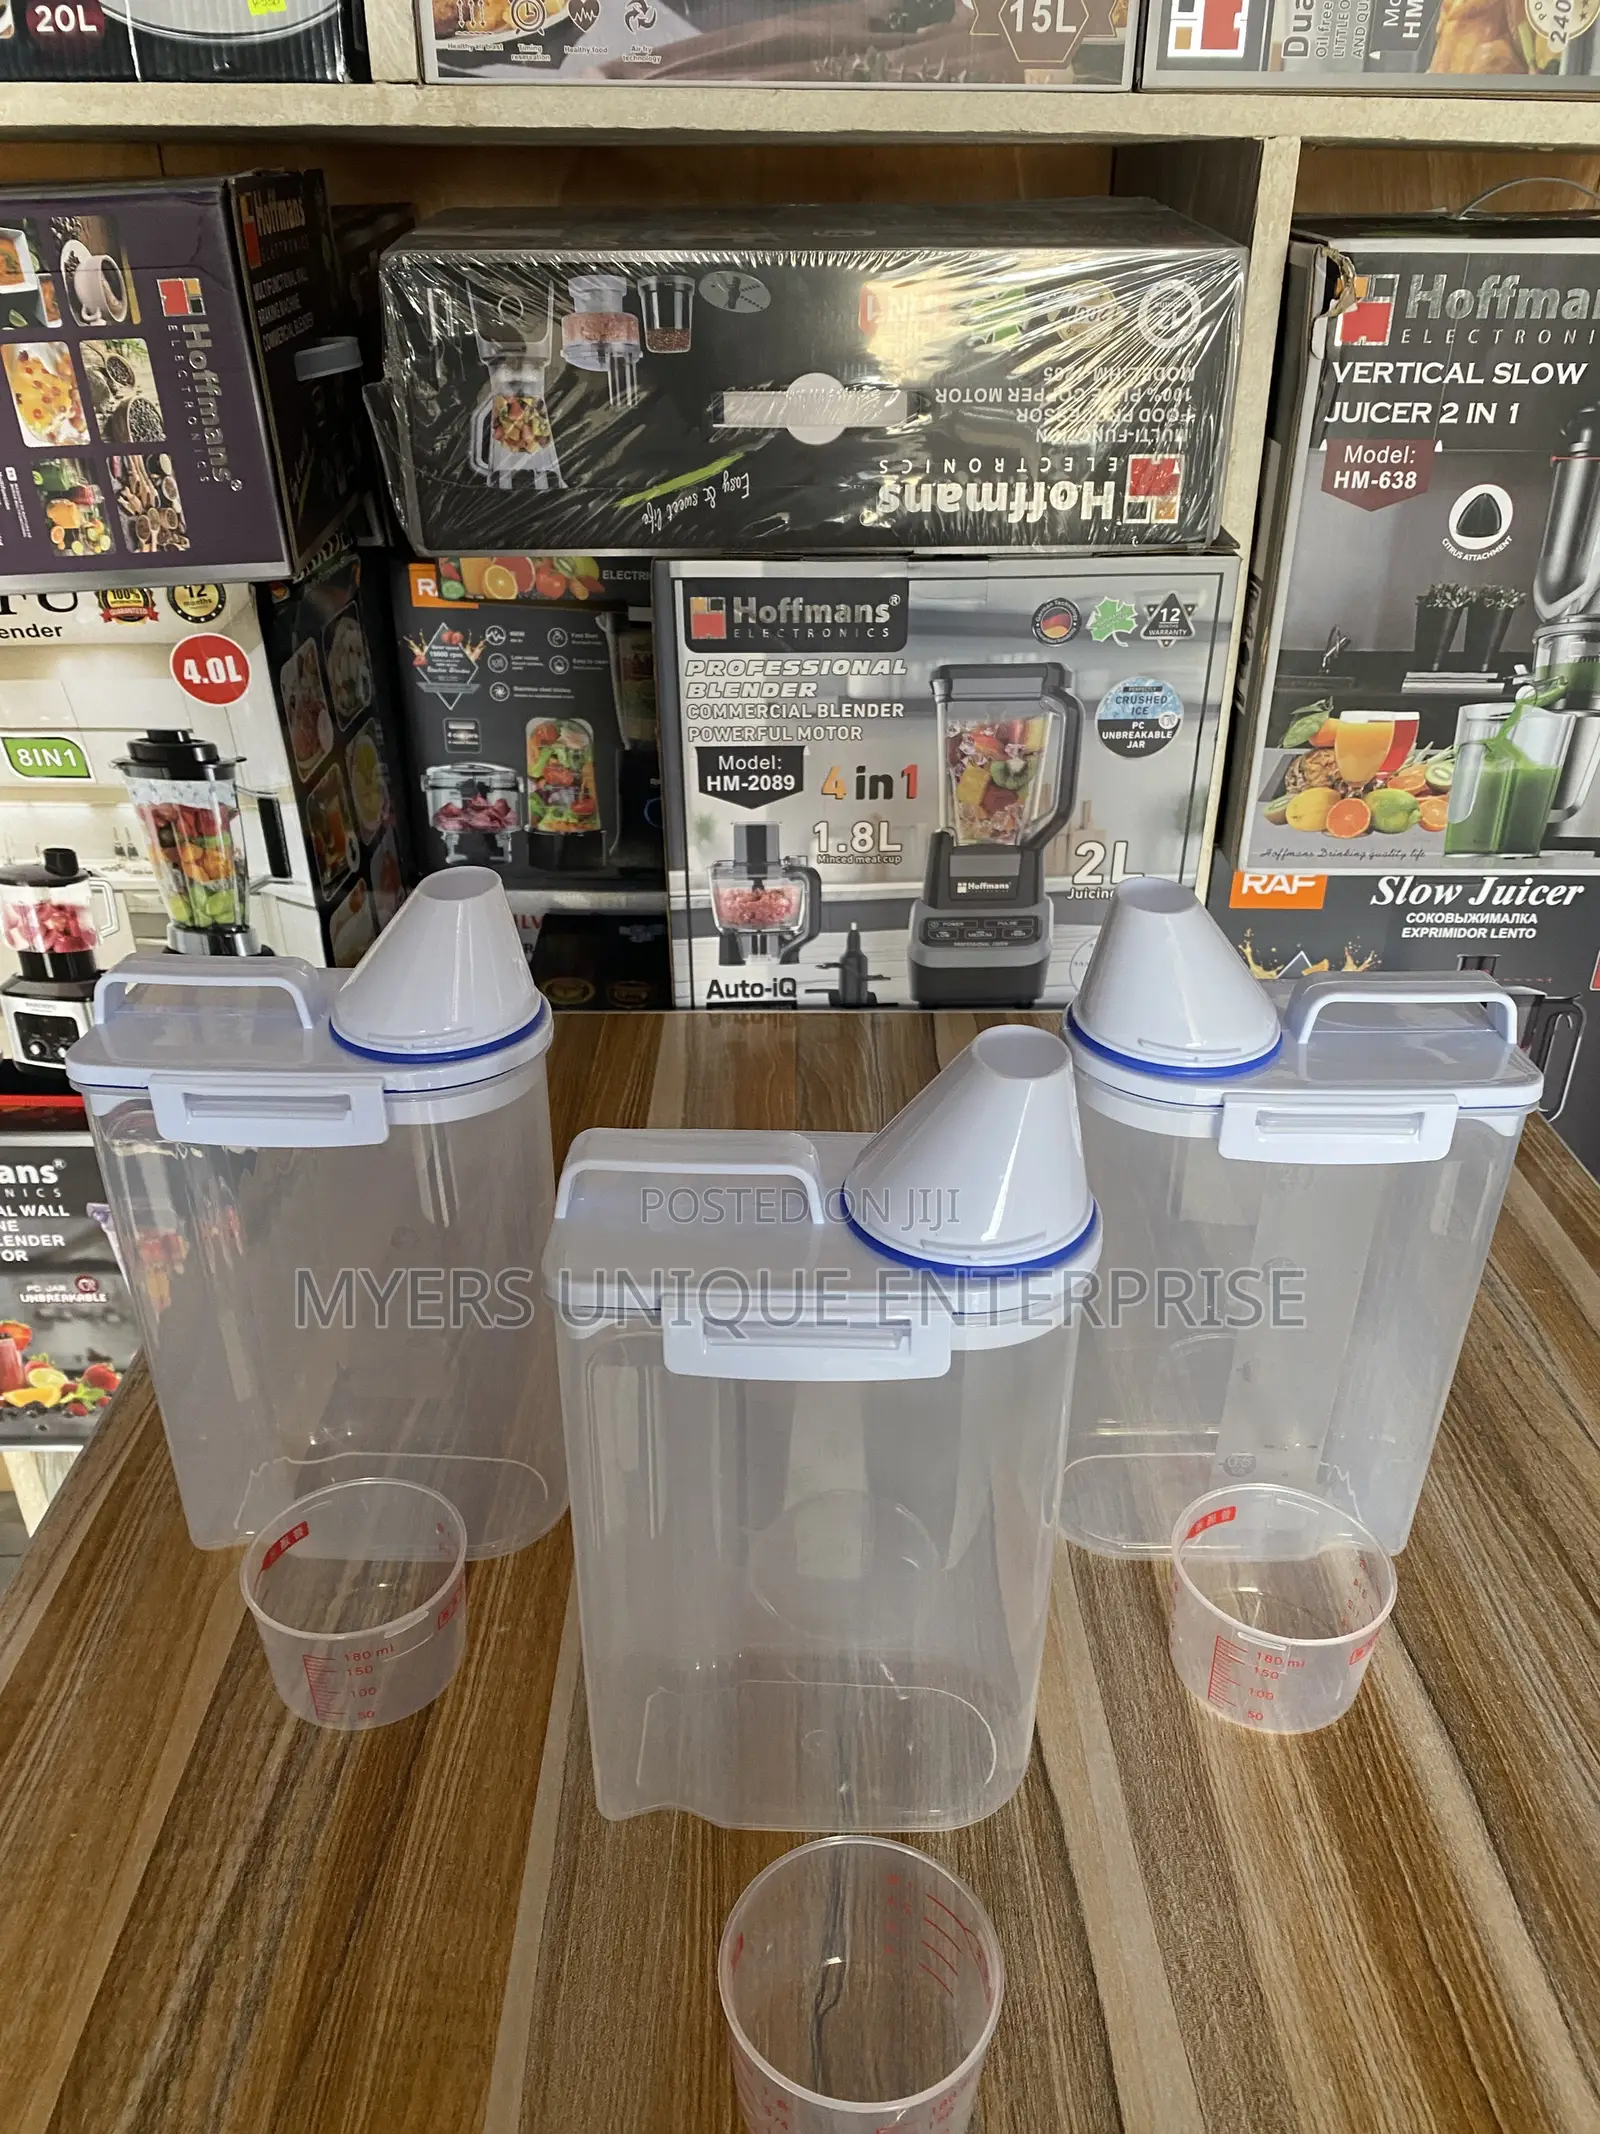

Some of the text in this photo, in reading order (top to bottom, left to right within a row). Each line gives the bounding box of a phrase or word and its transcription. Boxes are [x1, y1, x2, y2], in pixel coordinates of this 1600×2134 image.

[35, 5, 97, 32] 20L
[1009, 0, 1077, 33] 15L
[1334, 12, 1349, 58] LITTLE
[1353, 27, 1366, 58] AND
[448, 43, 472, 51] Healthy
[518, 44, 542, 53] Timing
[564, 46, 608, 54] Healthy food
[631, 45, 643, 53] Air
[1316, 37, 1328, 57] Oil
[622, 54, 661, 63] technology
[1401, 328, 1594, 345] ELECTRONI
[1332, 361, 1589, 385] VERTICAL SLOW
[935, 388, 1006, 403] MOTOR
[1090, 387, 1141, 402] PUE
[168, 324, 209, 482] ELECTRONICS
[1016, 408, 1134, 422] PRESSOR
[1324, 401, 1519, 424] JUICER 2 IN 1
[1036, 427, 1188, 443] MULTI-FUNCN
[1344, 445, 1416, 464] Model:
[879, 457, 1117, 474] ELECTRONICS
[1333, 470, 1417, 490] HM-638
[642, 470, 749, 534] Easy & sweet life
[1442, 535, 1512, 561] CITRUS ATTACHMENT
[602, 569, 652, 582] ELECTRI
[1160, 607, 1180, 622] 12
[734, 628, 890, 638] ELECTRONICS
[182, 655, 242, 685] 4.0L
[685, 658, 908, 677] PROFESSIONAL
[686, 681, 818, 698] BLENDER
[1115, 695, 1168, 705] CRUSHED
[687, 703, 904, 719] COMMERCIAL BLENDER
[1131, 706, 1149, 716] ICE
[1132, 721, 1145, 730] PC
[688, 726, 863, 742] POWERFUL MOTOR
[1102, 730, 1173, 740] UNBREAKABLE
[1126, 740, 1146, 749] JAR
[17, 747, 77, 768] 8IN1
[718, 755, 782, 770] Model:
[706, 775, 795, 791] HM-2089
[821, 764, 918, 800] 4 in 1
[813, 820, 903, 853] 1.8L
[817, 854, 902, 865] Minced meat cup
[1260, 847, 1426, 860] Hoffmans Drinking quality life
[1072, 841, 1145, 885] 2L
[1241, 874, 1317, 895] RAF
[1370, 876, 1585, 906] Slow Juicer
[1405, 912, 1538, 925] СОКОВЫЖИМАЛКА
[1401, 927, 1537, 939] EXPRIMIDOR LENTO
[706, 977, 798, 1000] Auto-iQ
[20, 1205, 70, 1217] WALL
[20, 1293, 107, 1303] UNBREAKABLE
[344, 1643, 395, 1662] 180 ml
[1256, 1651, 1283, 1666] 180
[347, 1665, 373, 1676] 150
[1254, 1666, 1279, 1680] 150
[350, 1686, 377, 1698] 100
[1249, 1687, 1274, 1701] 100
[358, 1710, 376, 1720] 50
[1247, 1711, 1264, 1721] 50
